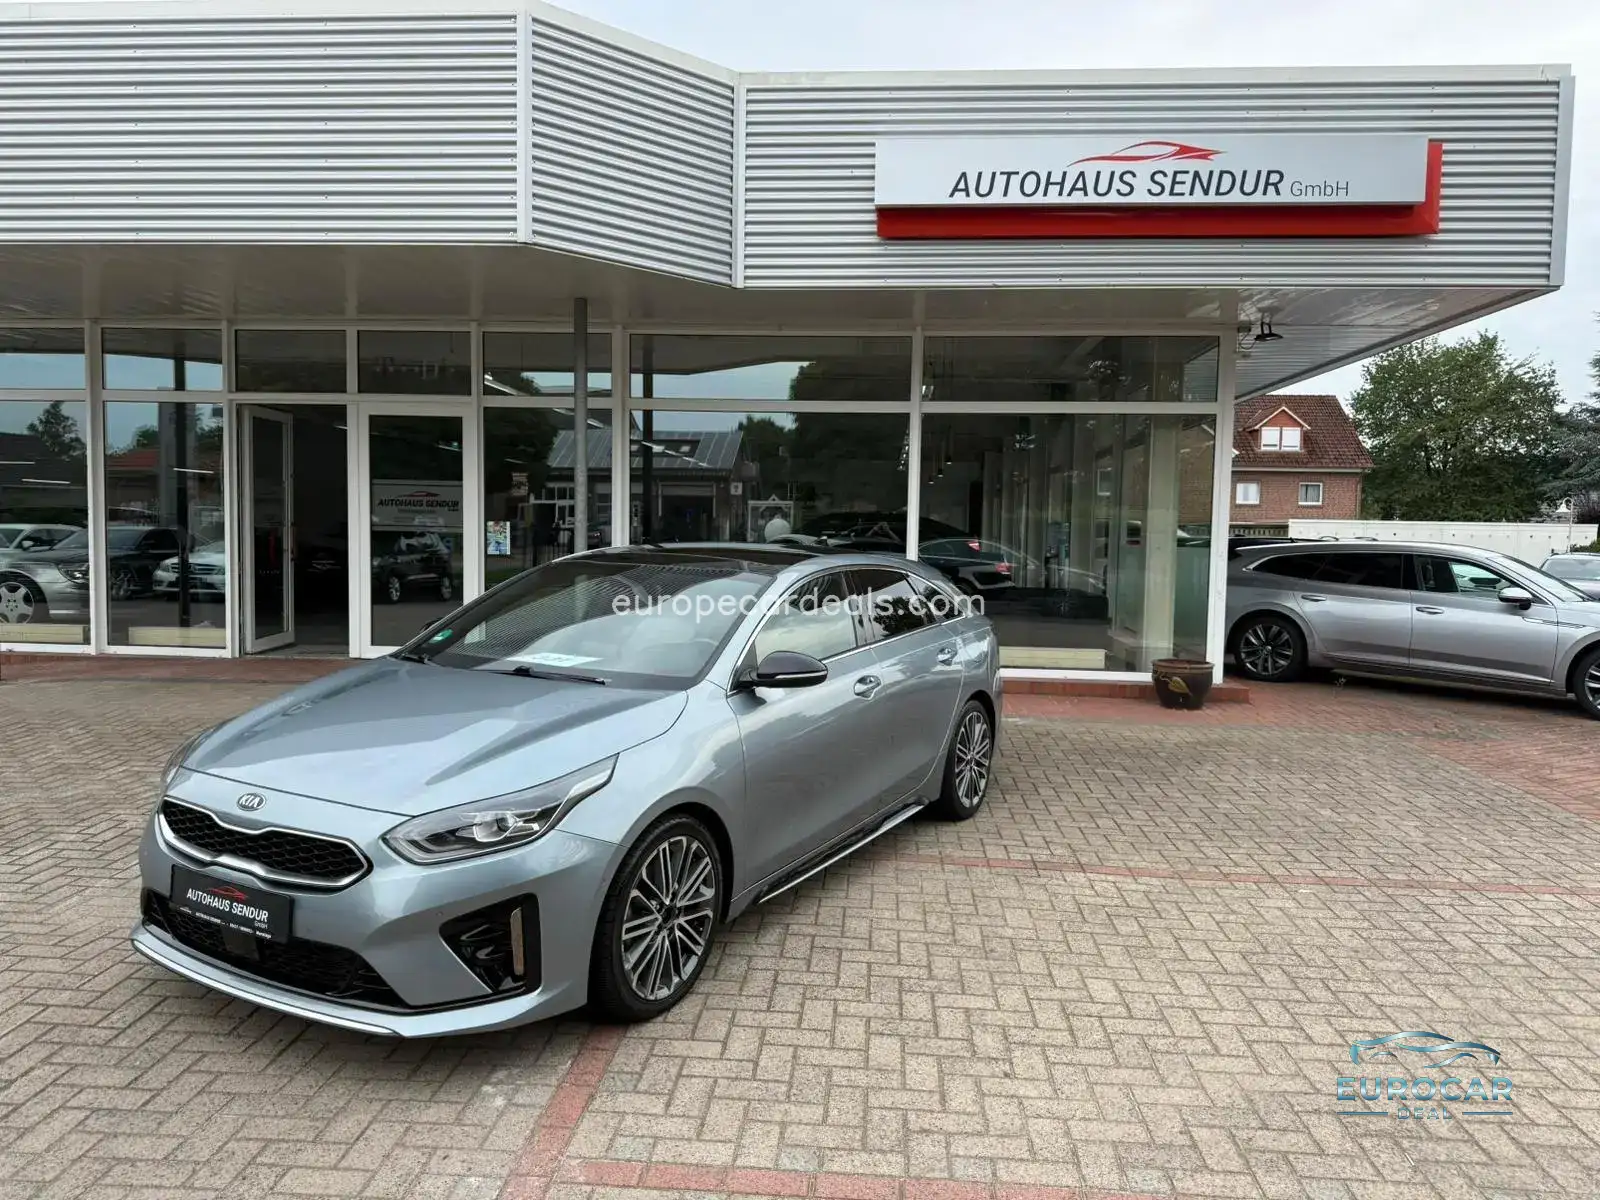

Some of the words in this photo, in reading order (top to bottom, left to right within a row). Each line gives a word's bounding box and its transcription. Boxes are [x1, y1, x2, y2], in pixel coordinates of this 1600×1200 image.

[948, 169, 1137, 198] AUTOHAUS
[1146, 169, 1285, 198] SENDUR
[1290, 180, 1350, 198] GmbH
[377, 498, 423, 508] AUTOHAUS
[239, 794, 260, 808] KIA
[186, 887, 231, 912] AUTOHAUS
[231, 902, 269, 922] SENDUR
